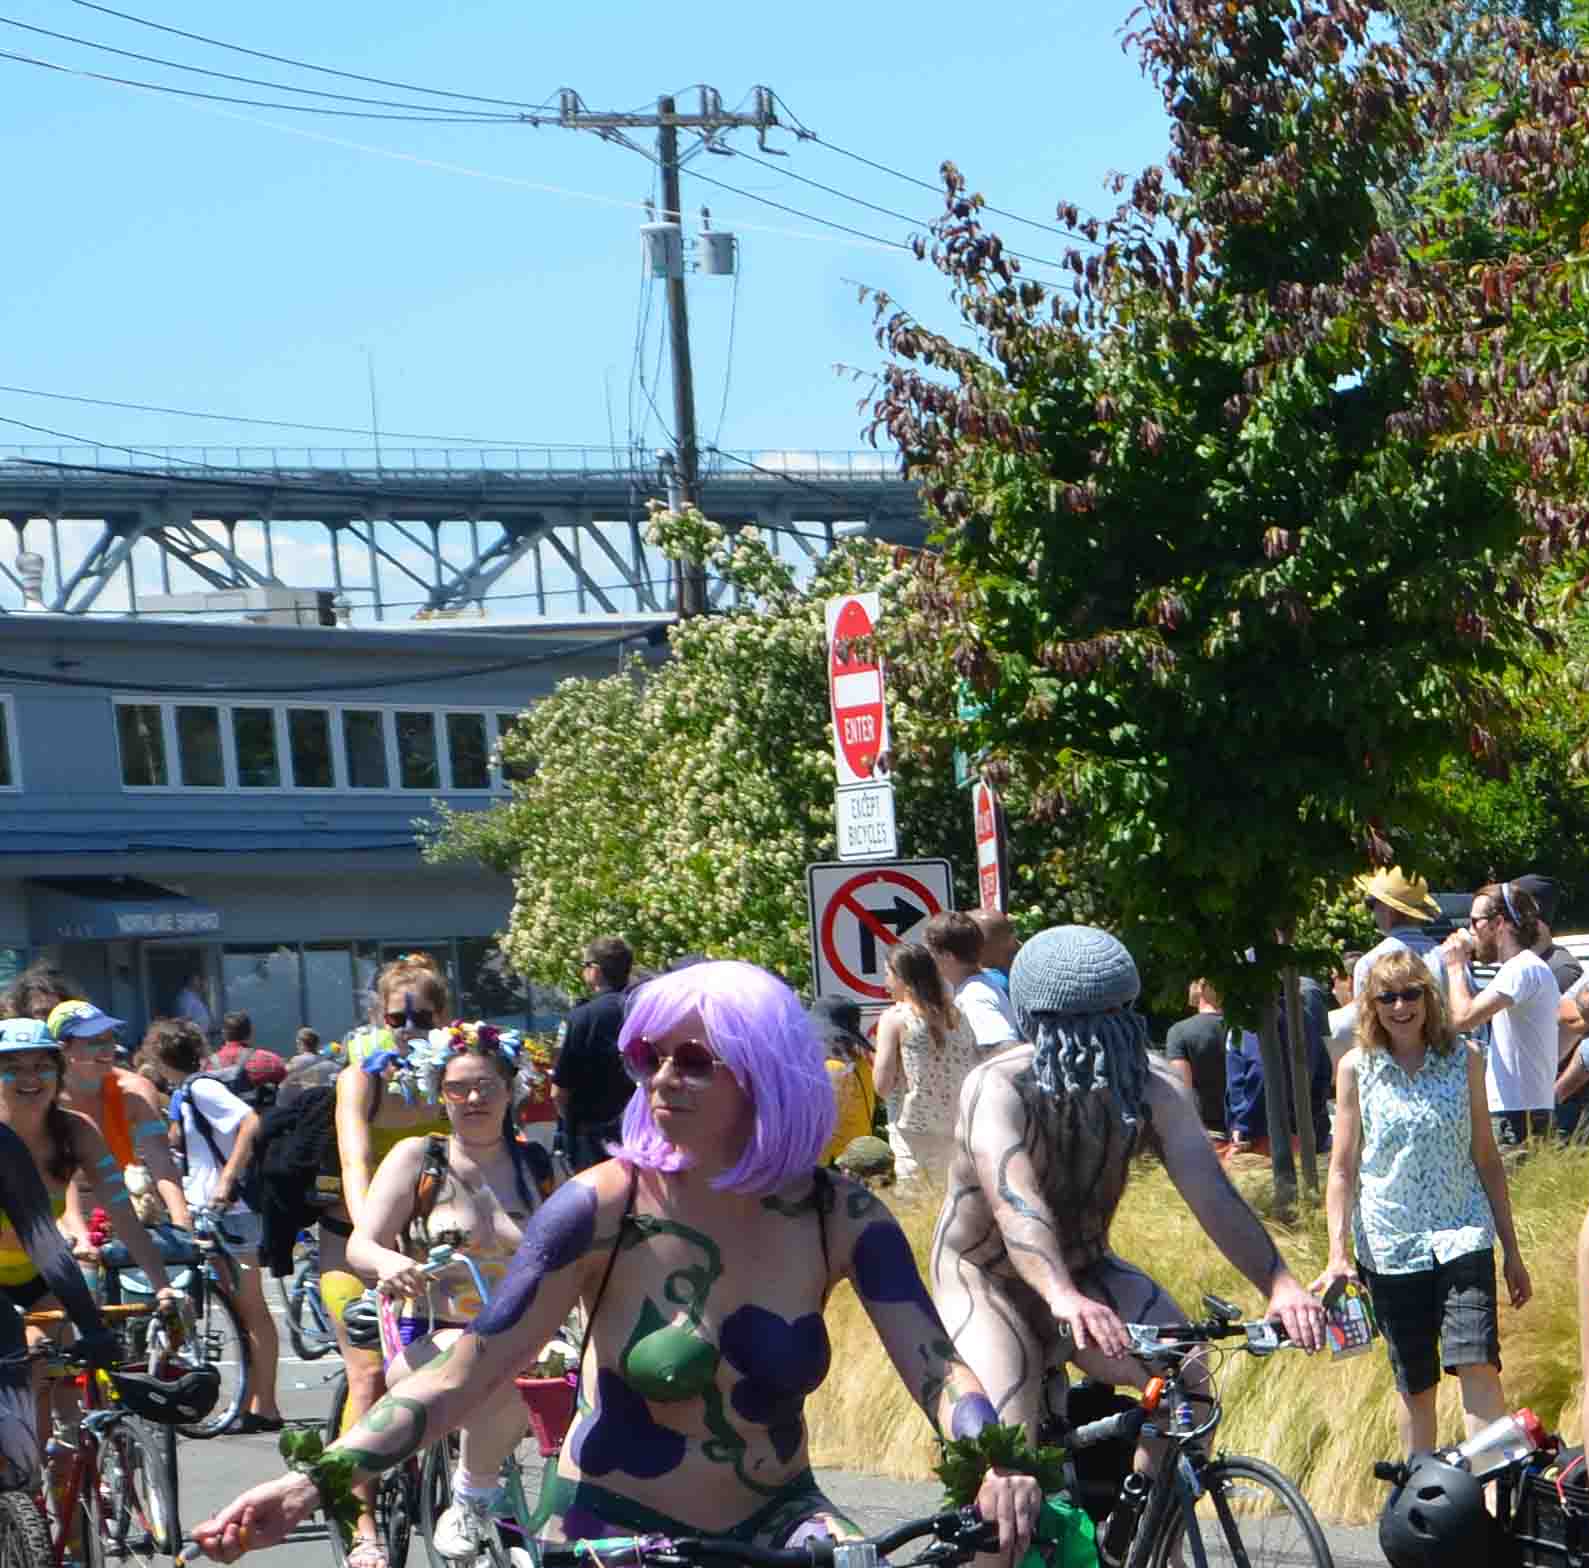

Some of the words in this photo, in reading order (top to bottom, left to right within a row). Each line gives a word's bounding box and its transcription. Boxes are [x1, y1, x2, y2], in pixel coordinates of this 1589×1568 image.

[844, 714, 874, 745] ENTER
[851, 795, 880, 819] EXCEPT
[848, 823, 887, 847] BICYCLES
